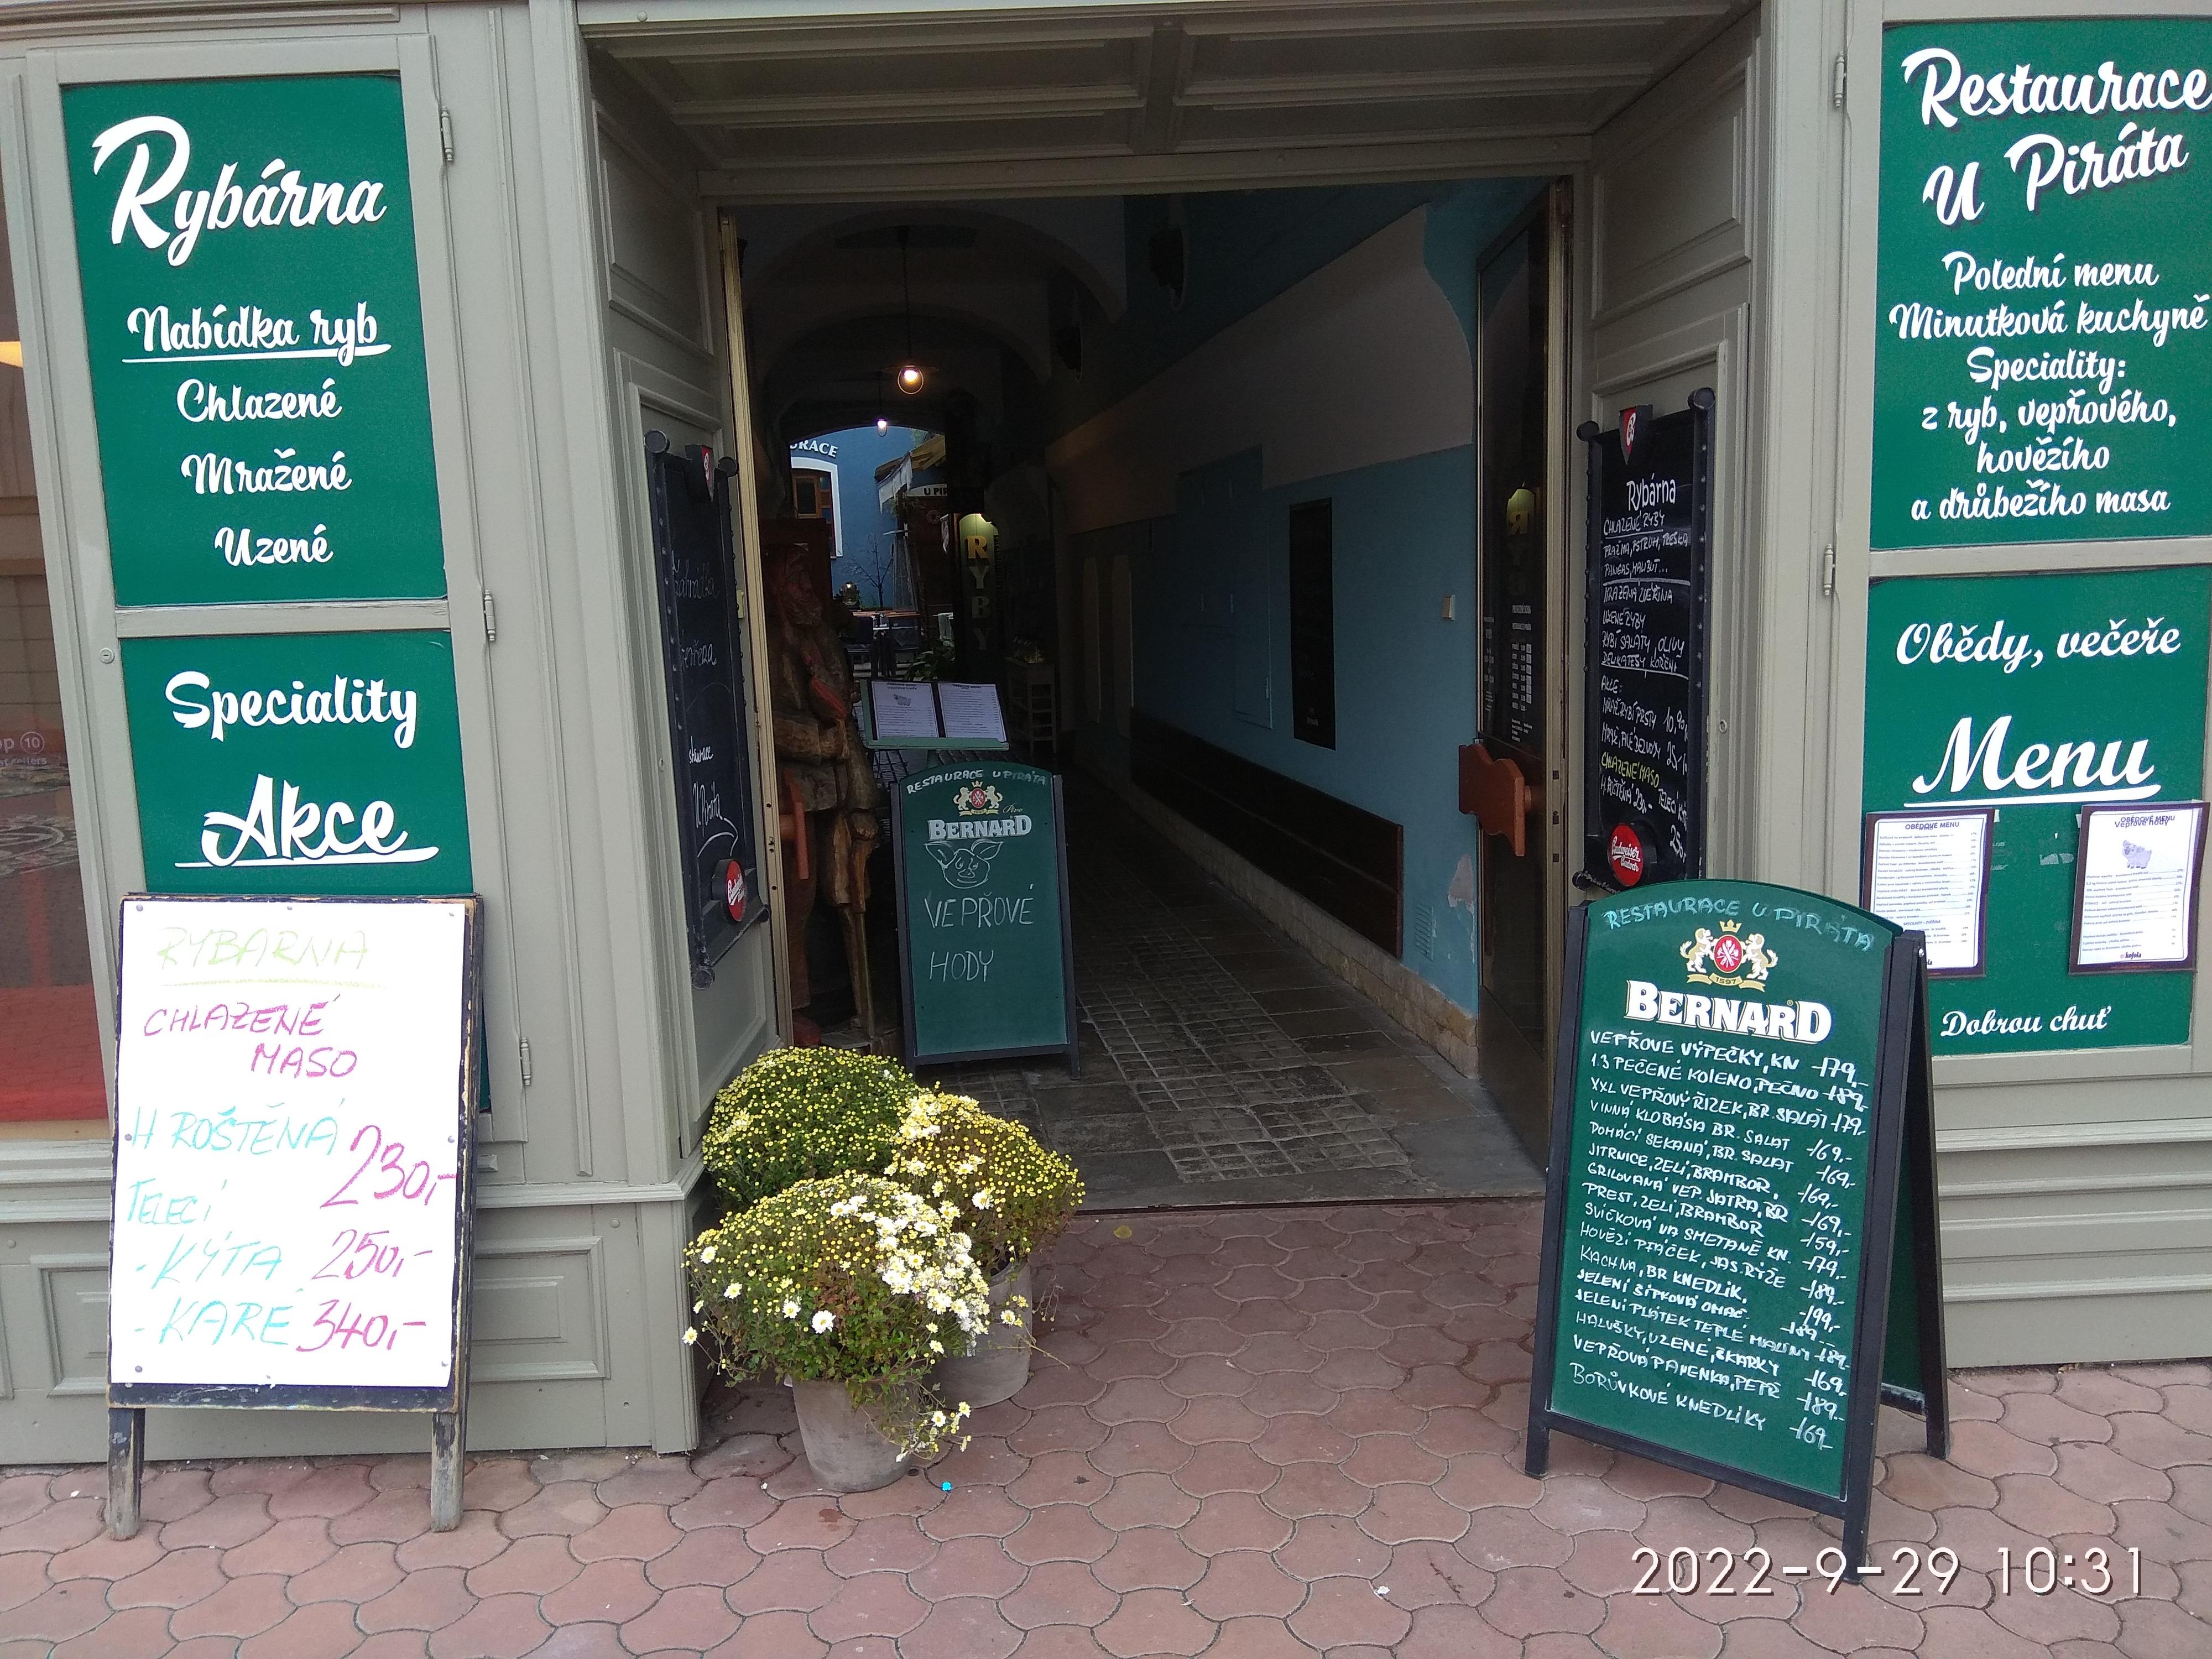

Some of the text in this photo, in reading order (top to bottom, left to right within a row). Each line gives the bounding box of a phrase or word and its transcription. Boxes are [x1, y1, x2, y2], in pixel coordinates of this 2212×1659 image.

[1901, 48, 2212, 128] Restaurace
[92, 116, 388, 267] Rybárna
[1922, 122, 2189, 226] U Piráta
[1943, 251, 2158, 295] Polední menu
[127, 301, 378, 367] Nabídka ryb
[1888, 295, 2210, 347] Minutková kuchyně
[1966, 346, 2126, 394] Speciality:
[176, 377, 342, 422] Chlazené
[1922, 389, 2176, 444] z ryb, vepřového,
[180, 447, 353, 495] Mražené
[1977, 437, 2110, 473] hovězího
[1626, 473, 1676, 511] Rybárna
[1911, 478, 2171, 520] a drůbežího masa
[215, 523, 334, 566] Uzené
[1896, 617, 2182, 674] Obědy, večeře
[165, 671, 416, 749] Speciality
[24, 737, 40, 748] 10
[1912, 716, 2154, 792] Menu
[906, 770, 984, 794] RESTAURACE
[201, 773, 408, 867] Akce
[927, 815, 1032, 841] BERNARD
[924, 884, 1034, 929] VEPŘOVÉ
[1603, 897, 1740, 930] RESTAURACE
[1752, 902, 1767, 917] U
[929, 949, 994, 983] HODY
[1715, 977, 1736, 985] 1597
[143, 994, 342, 1037] CHLAZENÉ
[1623, 979, 1833, 1045] BERNARD
[1940, 1005, 2112, 1038] Dobrou chuť
[251, 1043, 358, 1078] MASO
[1771, 1053, 1800, 1070] KN
[1590, 1077, 1616, 1093] XXL
[131, 1107, 158, 1150] H
[171, 1097, 346, 1155] ROŠTĚNÁ
[1589, 1121, 1642, 1141] DOMÁCÍ
[1590, 1099, 1634, 1118] VINNÁ
[1635, 1108, 1705, 1132] KLOBÁSA
[1588, 1162, 1668, 1191] GRILOVANÁ
[127, 1177, 228, 1225] TELECÍ
[1646, 1265, 1667, 1280] BR
[1569, 1363, 1671, 1404] BORŮVKOVÉ
